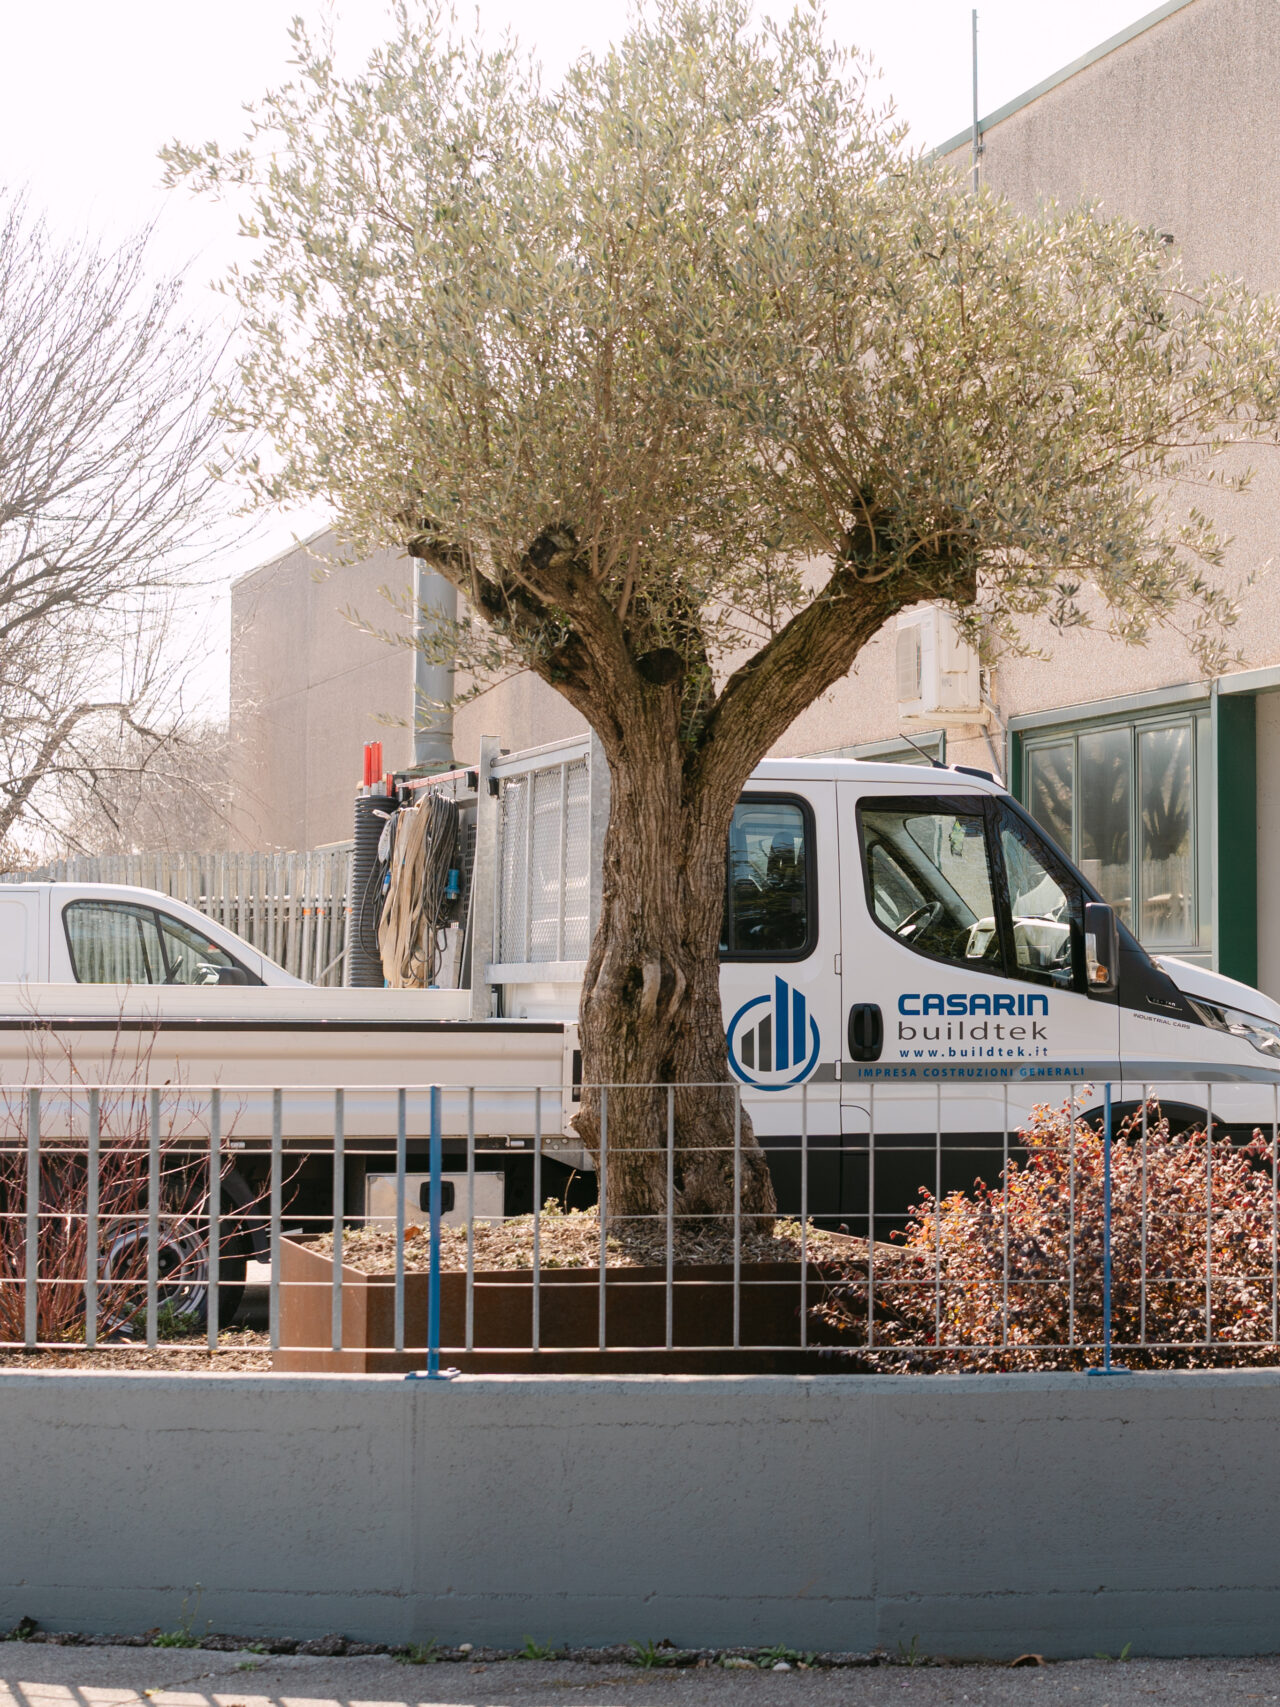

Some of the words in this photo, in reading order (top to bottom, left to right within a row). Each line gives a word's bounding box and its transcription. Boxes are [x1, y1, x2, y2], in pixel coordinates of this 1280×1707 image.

[898, 993, 1049, 1016] CASARIN
[1133, 1013, 1172, 1026] INDUSTRIAL
[1172, 1021, 1191, 1030] CARS
[898, 1021, 1048, 1040] buildtek
[900, 1046, 1048, 1058] www.buildtek.it
[858, 1068, 917, 1078] IMPRESA
[923, 1068, 1014, 1078] COSTRUZIONI
[1019, 1067, 1085, 1077] GENERALI
